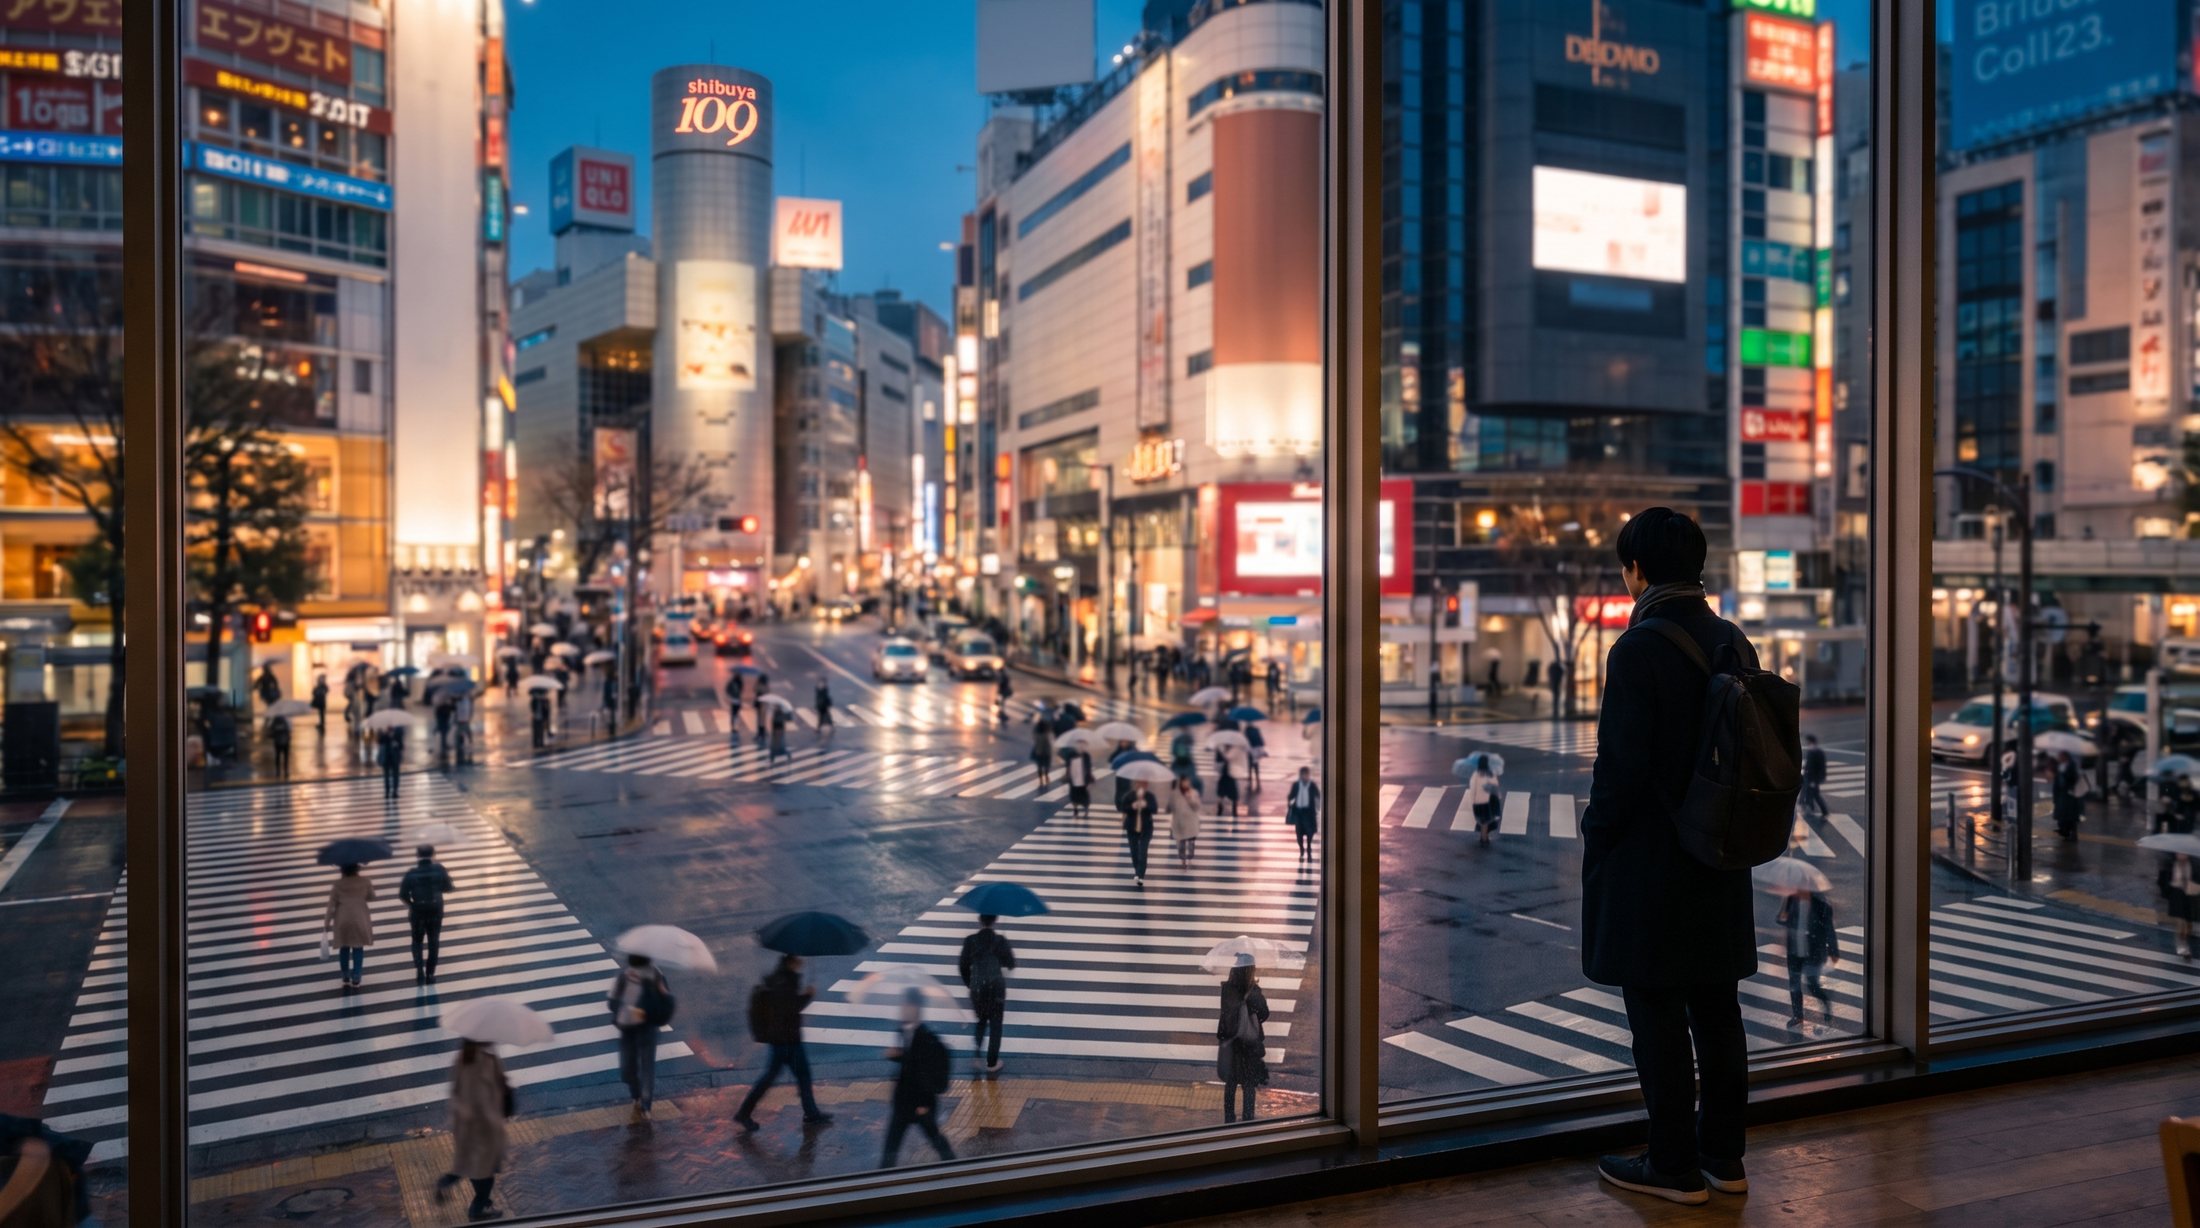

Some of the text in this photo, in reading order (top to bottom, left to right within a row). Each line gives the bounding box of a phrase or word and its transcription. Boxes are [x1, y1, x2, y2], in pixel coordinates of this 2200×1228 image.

[687, 79, 757, 100] shibuya
[674, 96, 758, 146] 109
[584, 166, 622, 187] UNI
[585, 189, 624, 208] QLO
